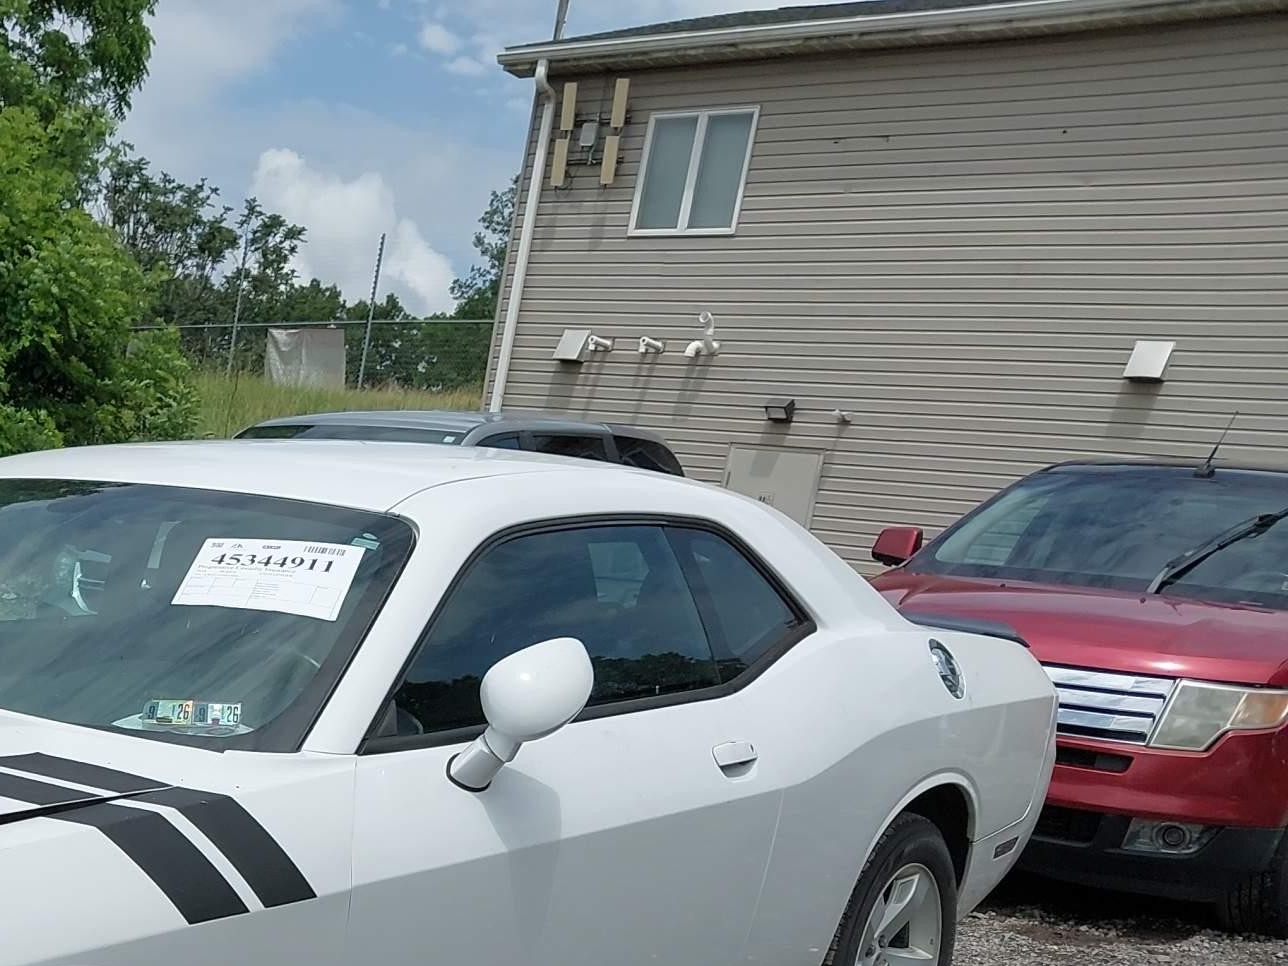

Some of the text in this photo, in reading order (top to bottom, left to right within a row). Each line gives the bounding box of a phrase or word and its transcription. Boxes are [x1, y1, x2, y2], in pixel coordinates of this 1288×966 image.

[210, 553, 335, 574] 45344911
[147, 704, 156, 720] 9
[176, 703, 190, 721] 26
[226, 705, 240, 723] 26
